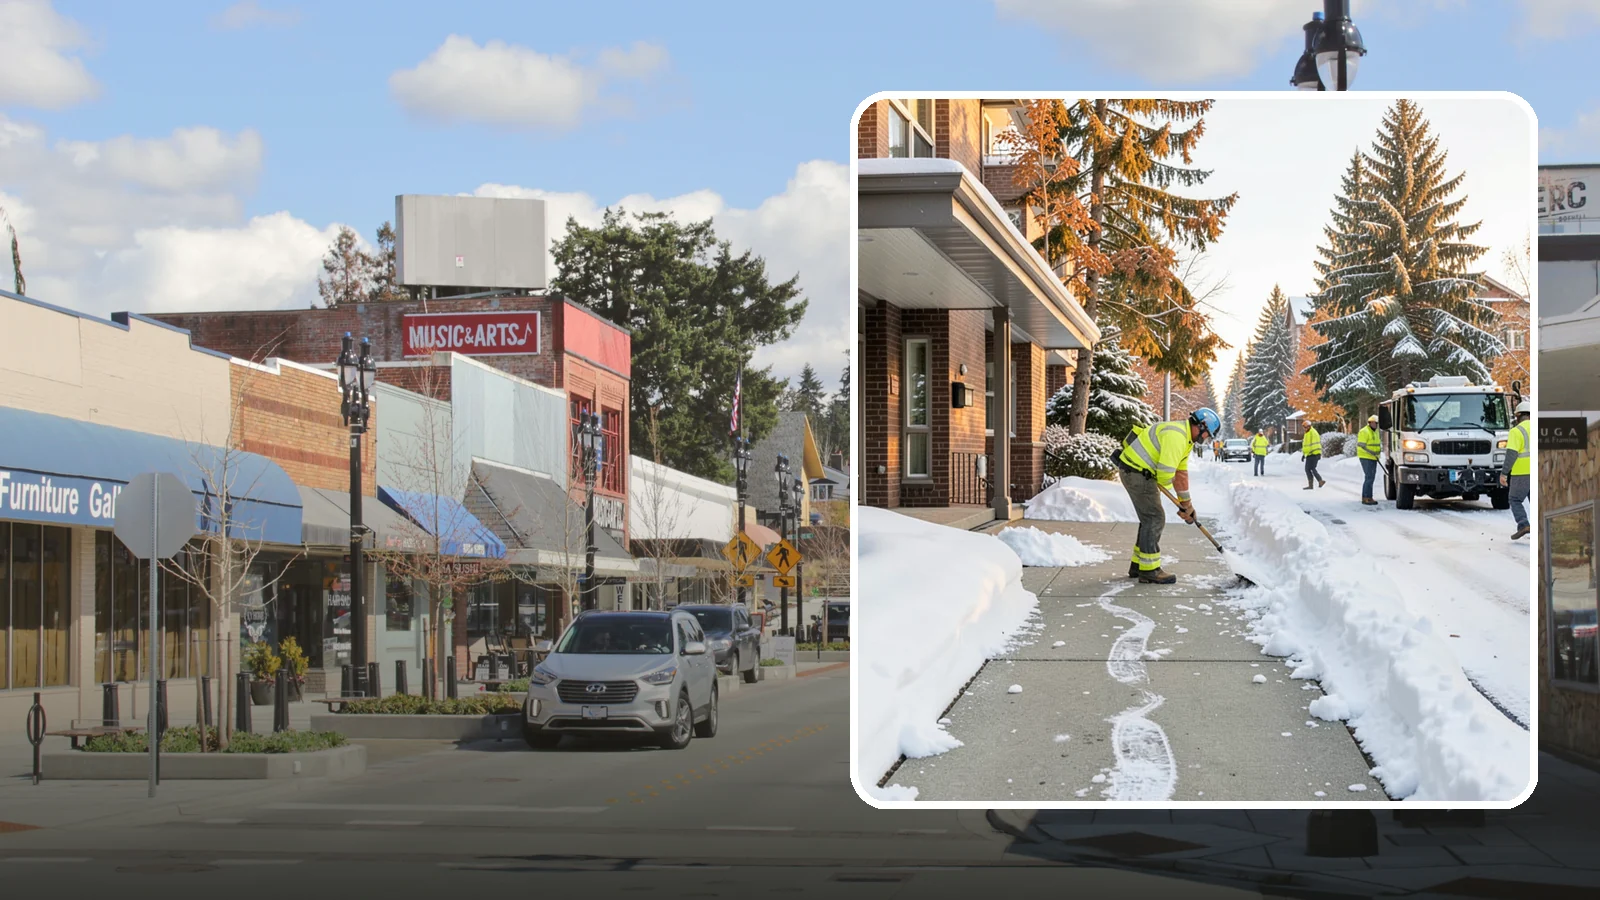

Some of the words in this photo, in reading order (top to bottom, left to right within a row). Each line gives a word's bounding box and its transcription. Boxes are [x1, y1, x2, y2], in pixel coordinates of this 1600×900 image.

[0, 472, 79, 515] Furniture
[90, 482, 121, 518] Gal
[453, 563, 479, 574] SUSHI
